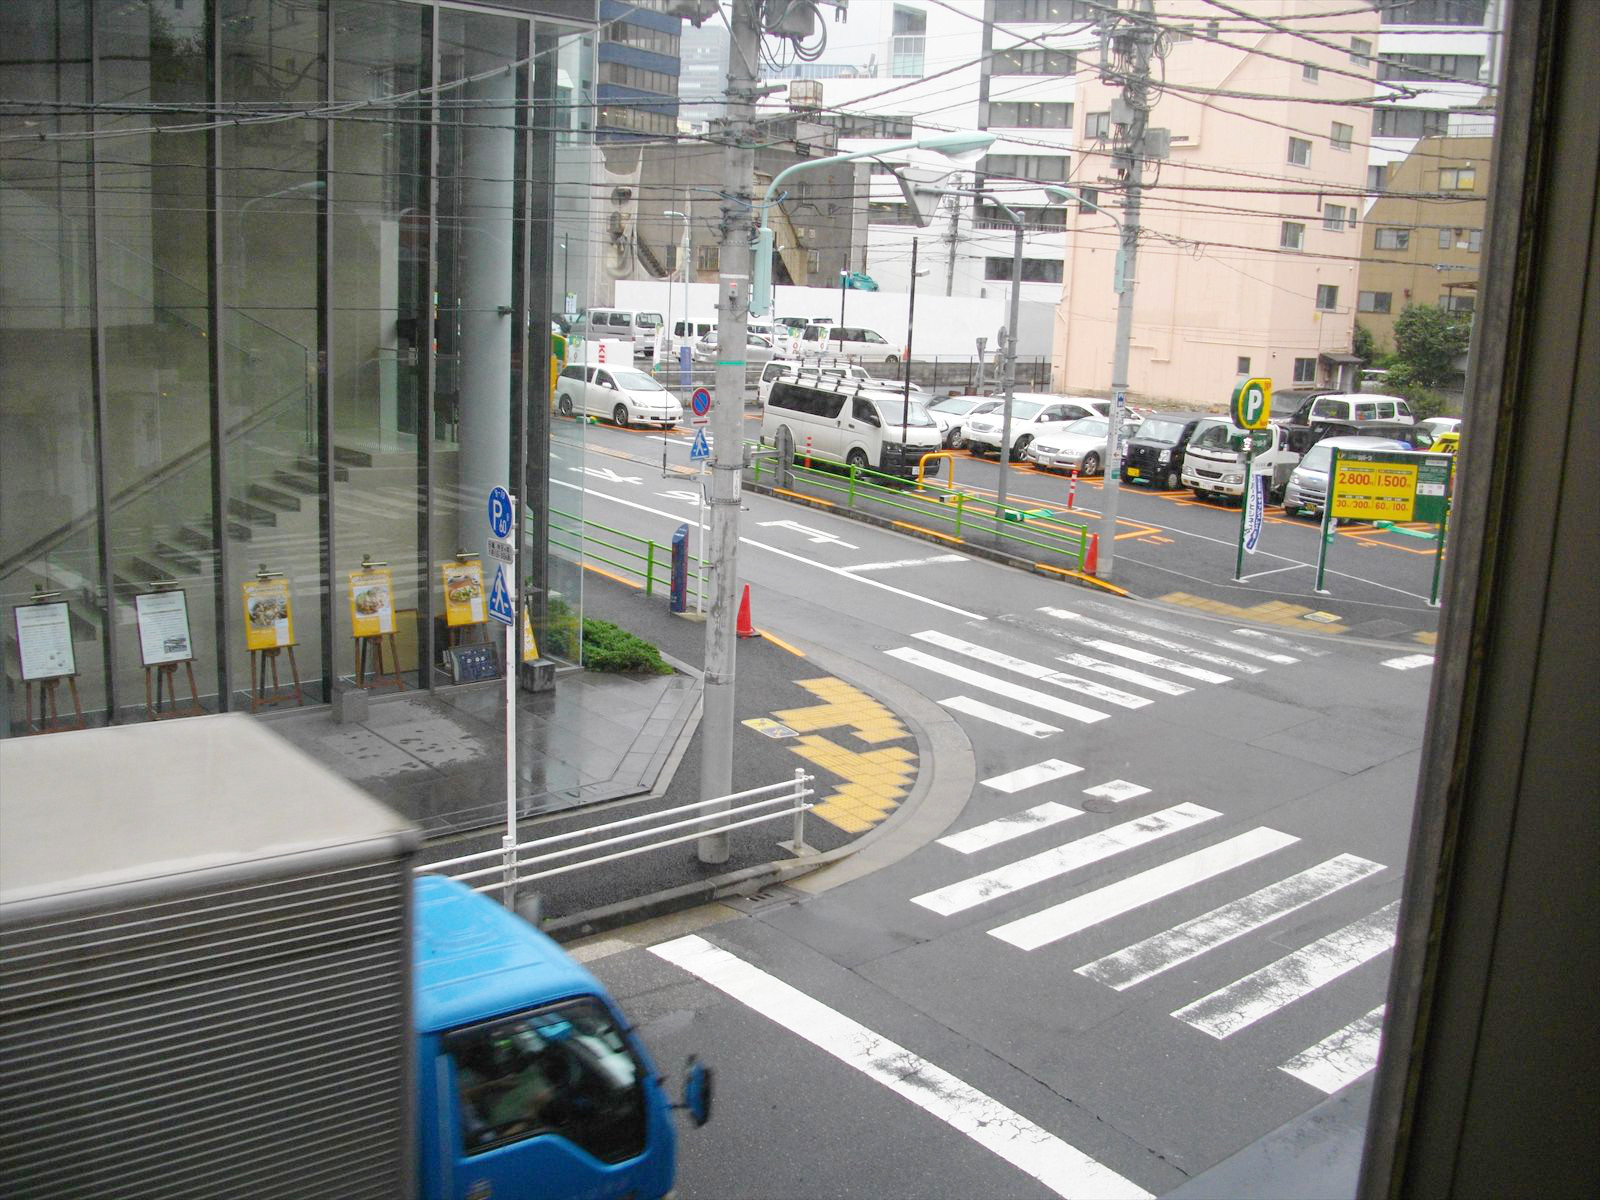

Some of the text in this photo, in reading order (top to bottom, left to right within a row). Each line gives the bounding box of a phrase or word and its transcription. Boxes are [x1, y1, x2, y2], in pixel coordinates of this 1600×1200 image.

[1247, 389, 1262, 421] P
[492, 499, 503, 530] P
[1353, 500, 1369, 509] 300
[499, 519, 507, 534] 60
